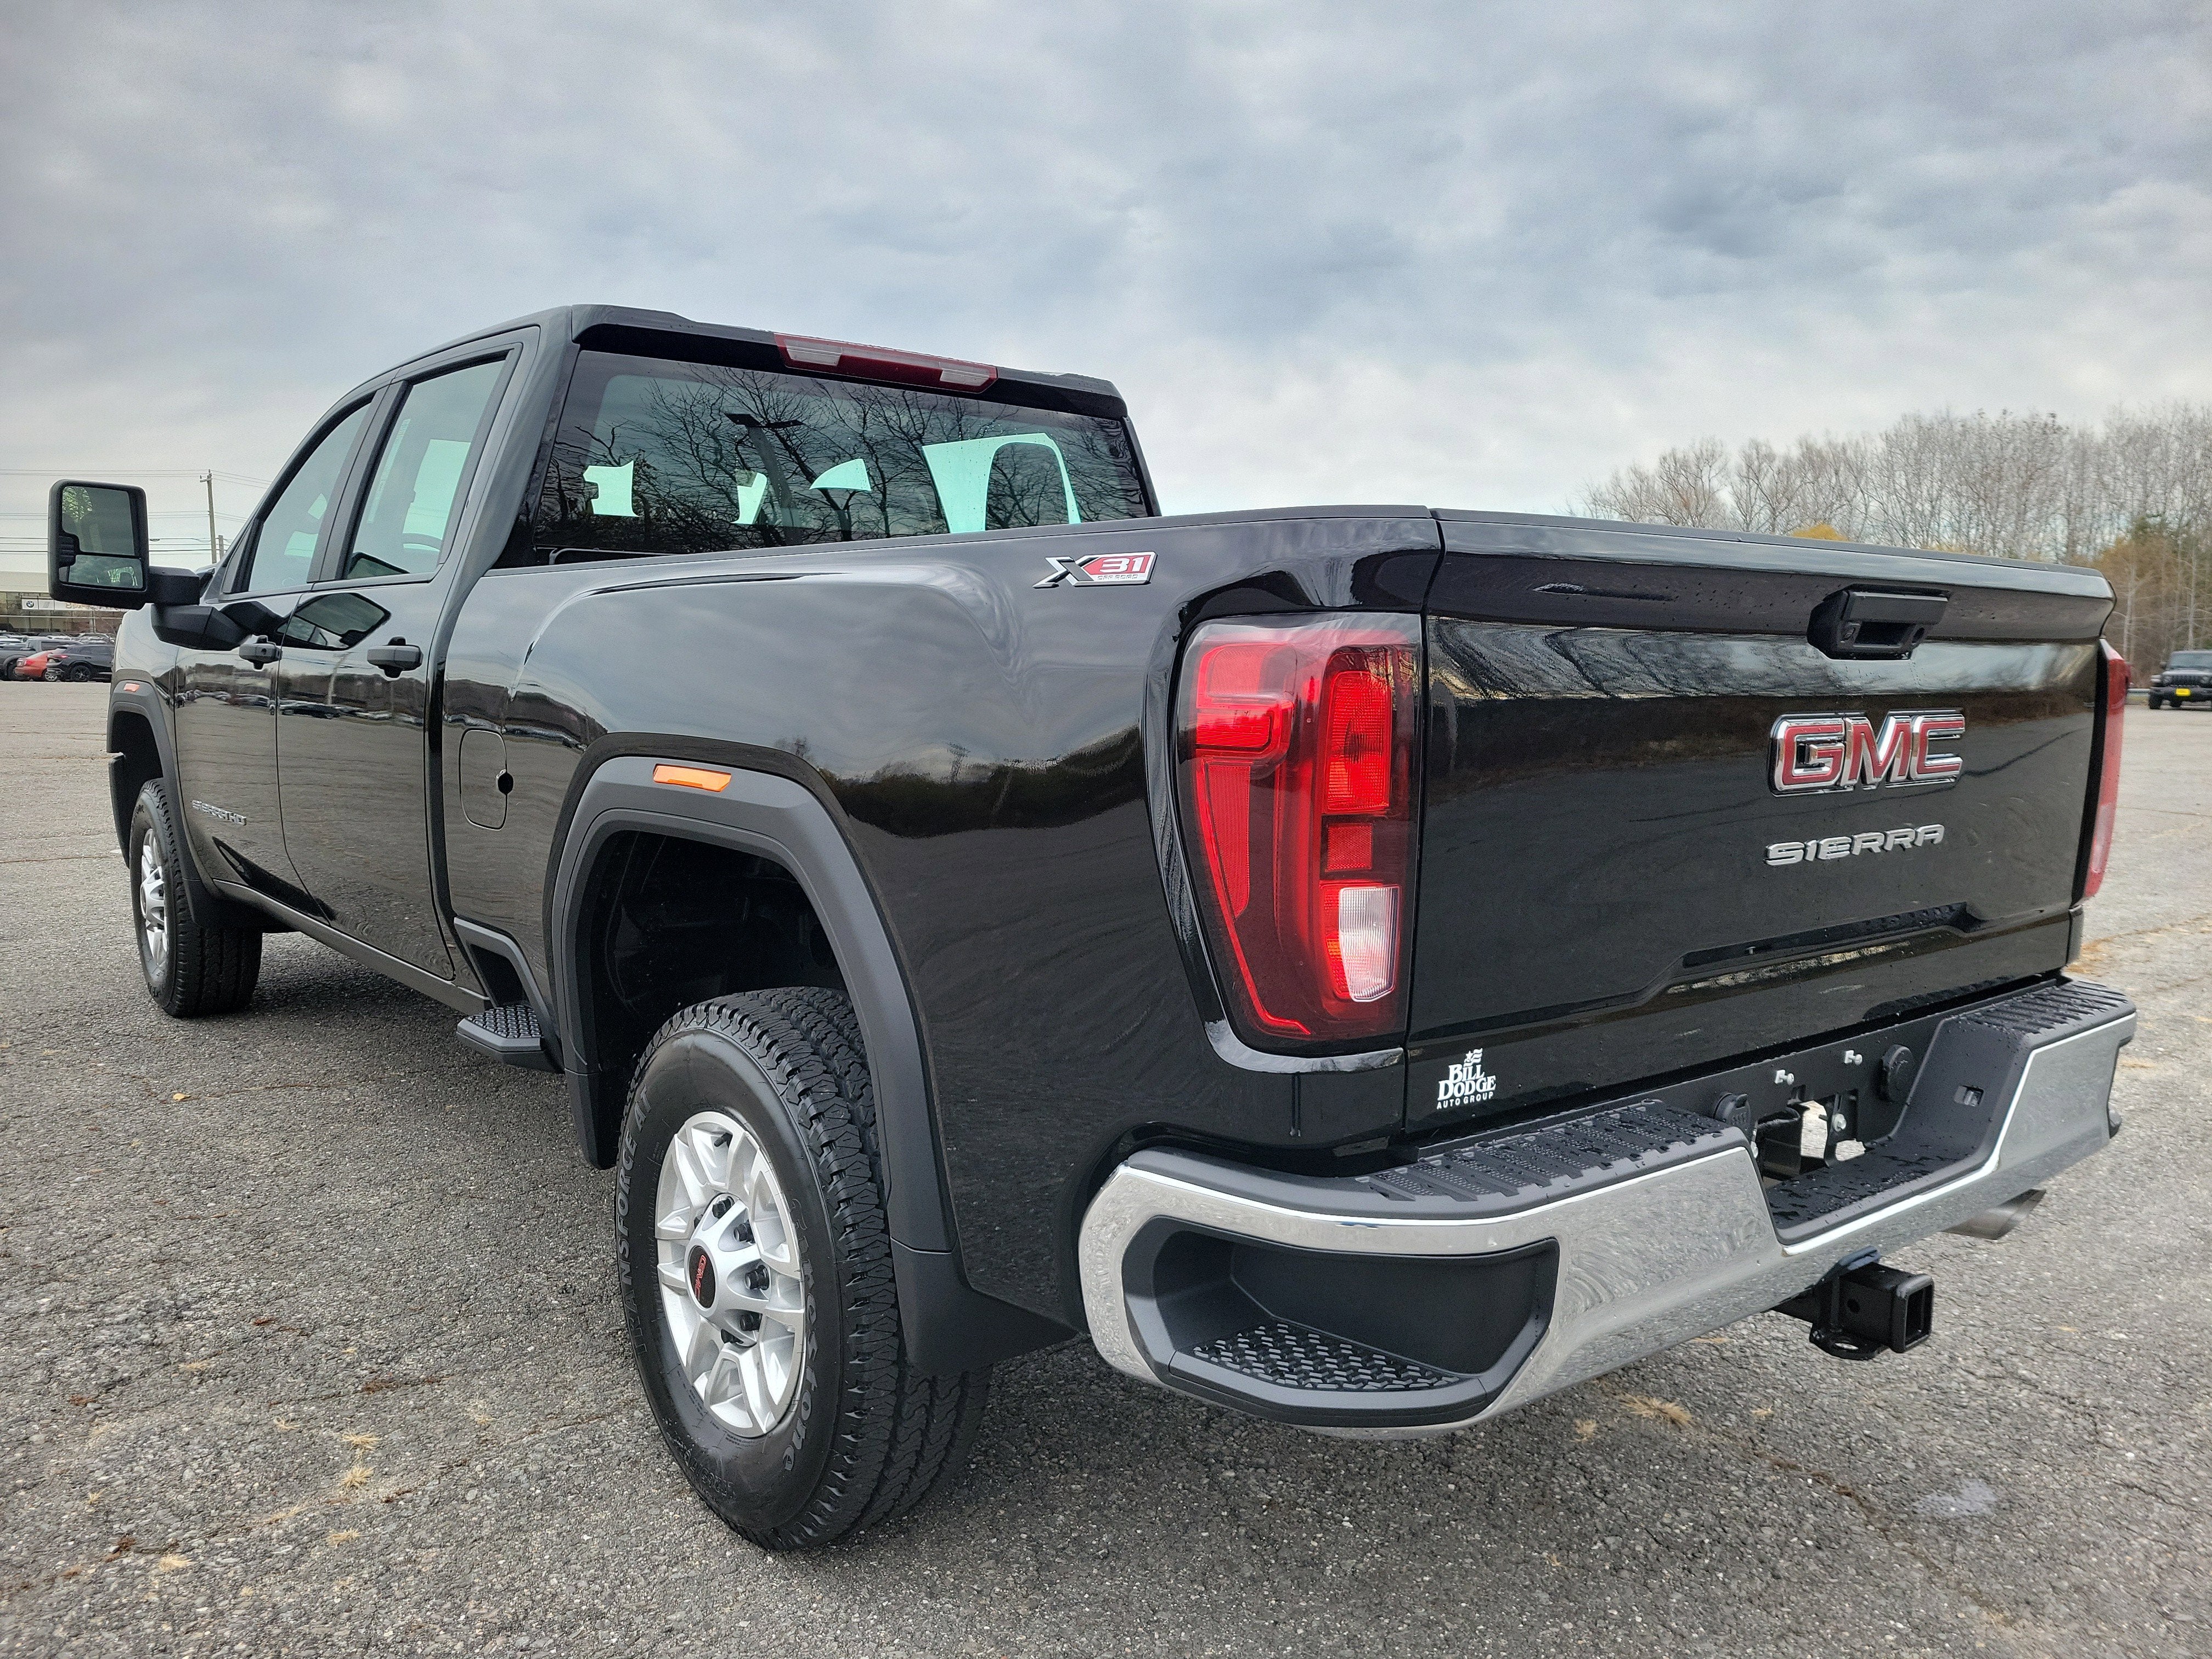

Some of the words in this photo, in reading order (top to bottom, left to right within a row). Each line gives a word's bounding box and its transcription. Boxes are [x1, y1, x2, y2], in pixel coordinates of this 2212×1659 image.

[1032, 554, 1146, 589] X31
[1769, 712, 1966, 795] GMC
[1764, 823, 1945, 866] SIERRA
[1437, 1075, 1497, 1101] DODGE
[1448, 1064, 1485, 1084] BILL
[1436, 1098, 1461, 1110] AUTO
[1463, 1091, 1494, 1104] GROUP
[617, 1127, 647, 1356] TRANSFORCE
[635, 1084, 652, 1132] AT
